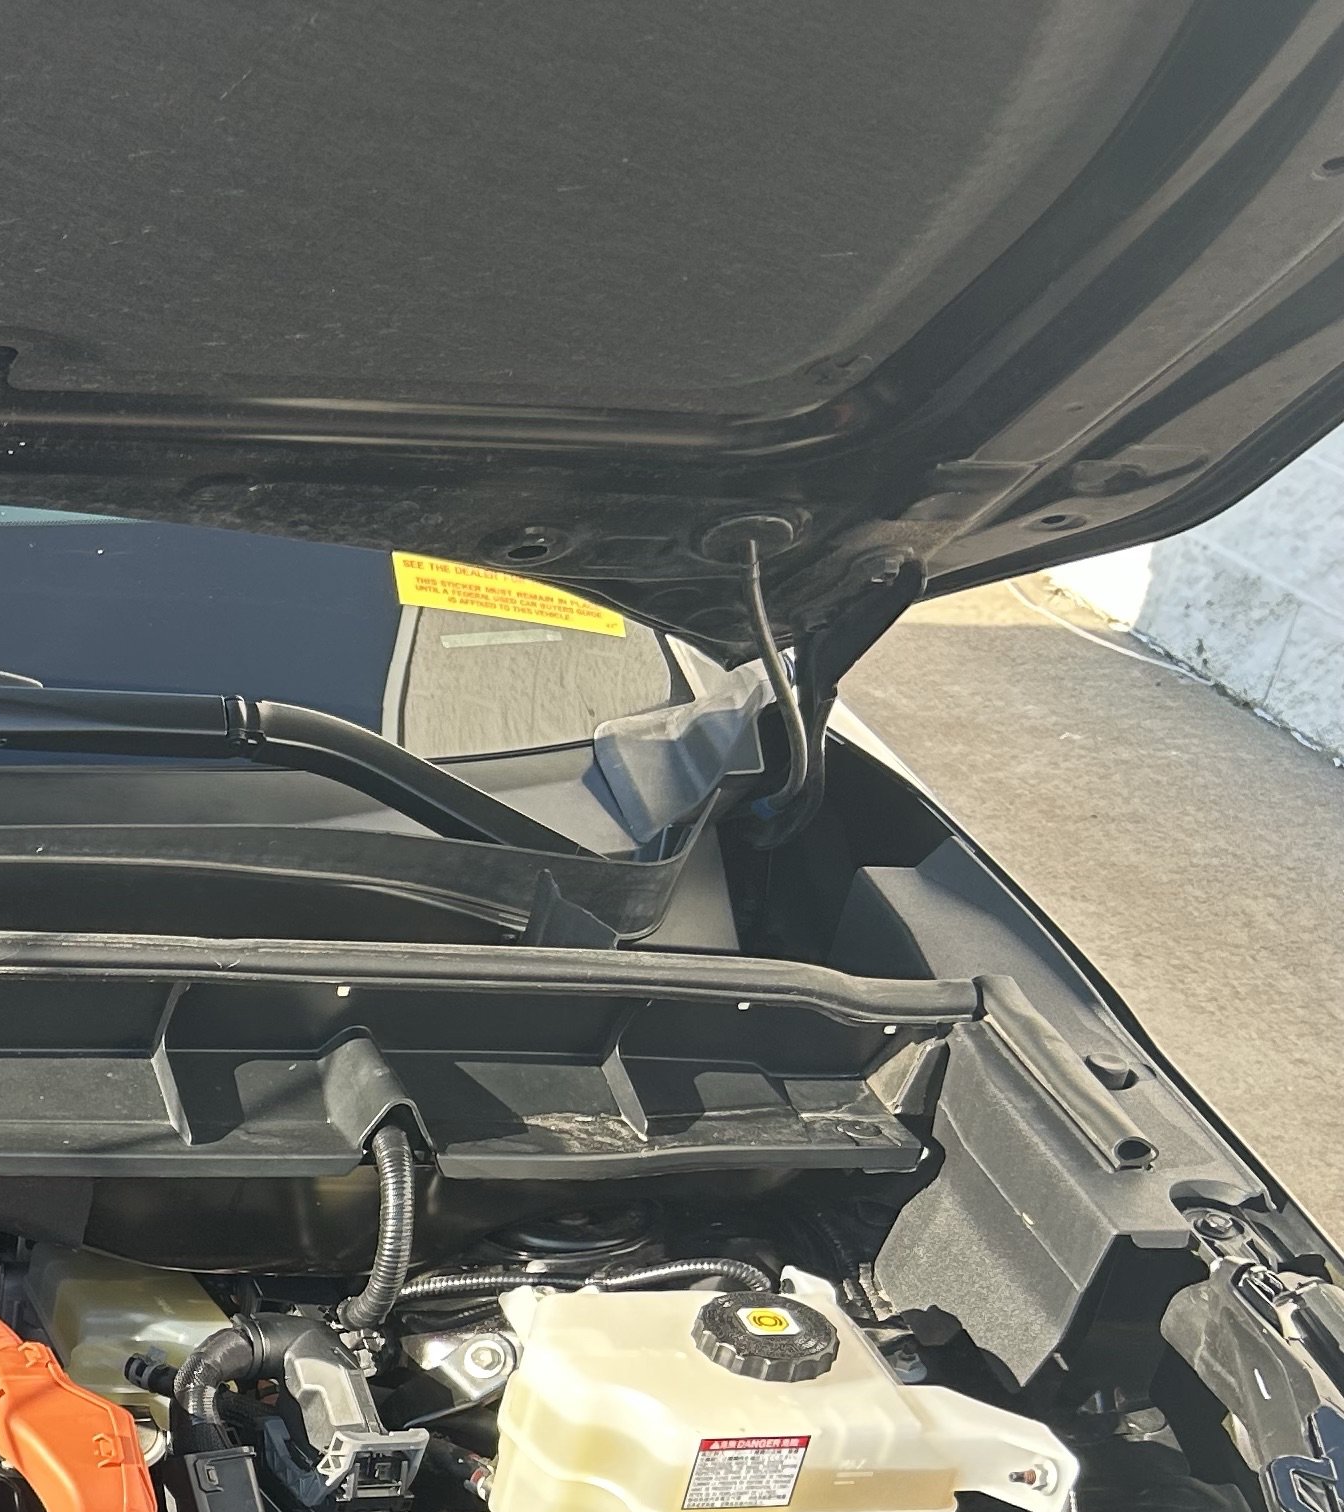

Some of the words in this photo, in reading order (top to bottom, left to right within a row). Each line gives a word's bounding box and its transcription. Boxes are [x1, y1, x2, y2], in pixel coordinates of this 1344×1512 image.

[402, 558, 425, 571] SEE
[429, 562, 451, 573] THE
[415, 576, 438, 585] THIS
[441, 580, 481, 592] STICKER
[485, 587, 512, 596] MUST
[415, 584, 441, 594] UNTIL
[736, 1439, 781, 1449] DANGER
